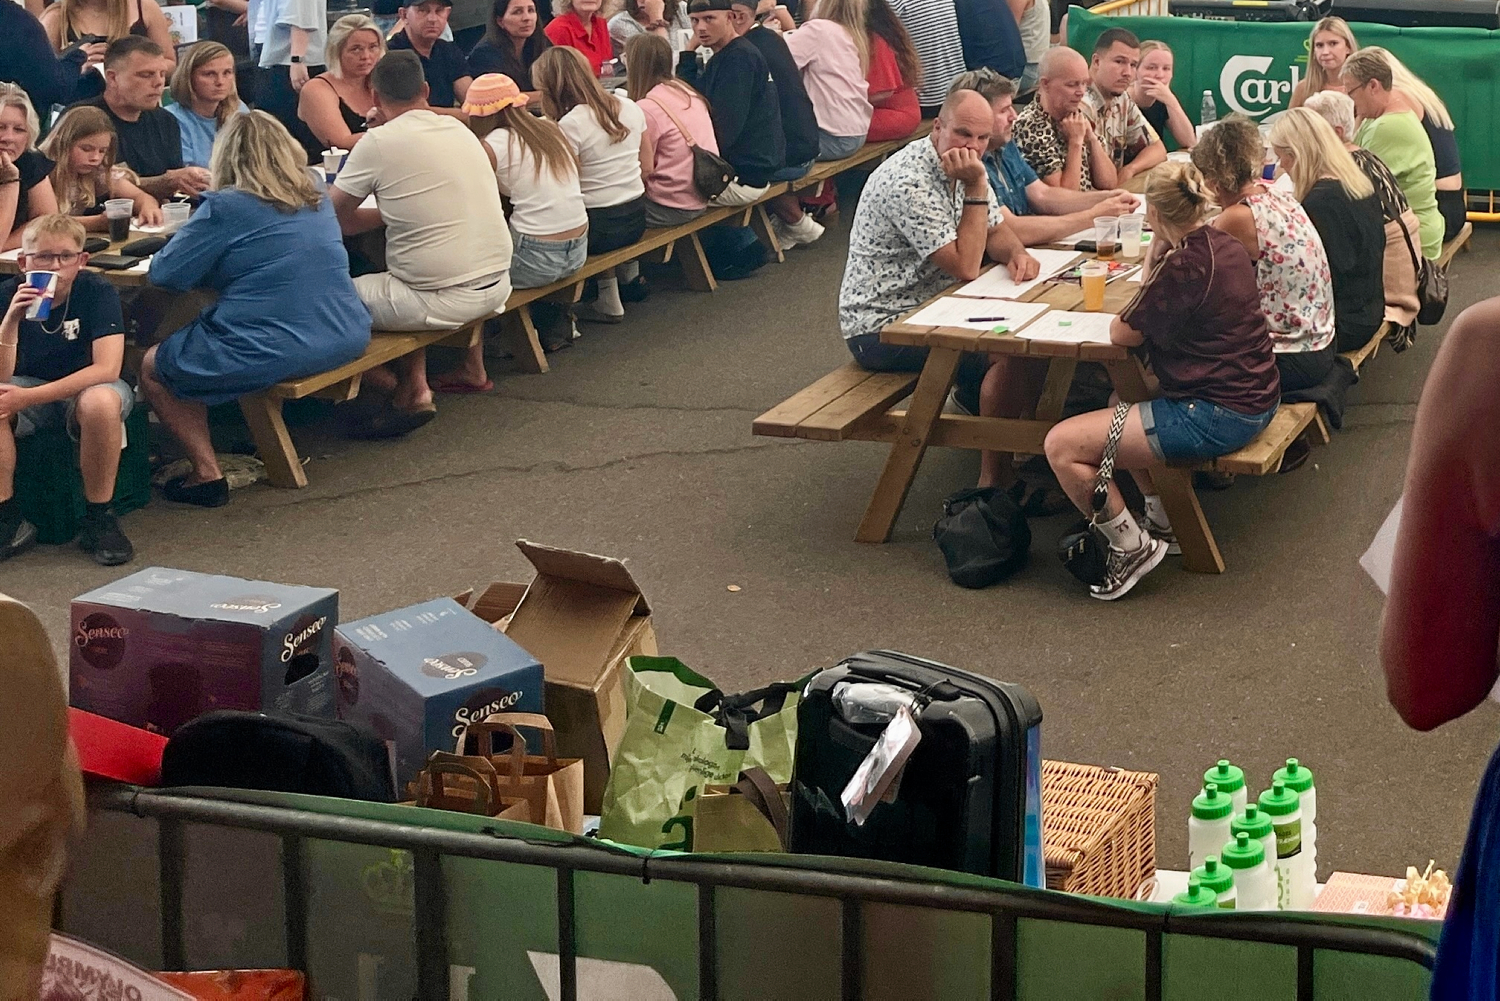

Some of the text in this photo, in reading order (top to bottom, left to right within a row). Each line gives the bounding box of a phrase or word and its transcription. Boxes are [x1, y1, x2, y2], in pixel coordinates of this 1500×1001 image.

[74, 620, 130, 648] Senseo
[279, 615, 328, 663] Senseo
[451, 690, 524, 738] Senseo
